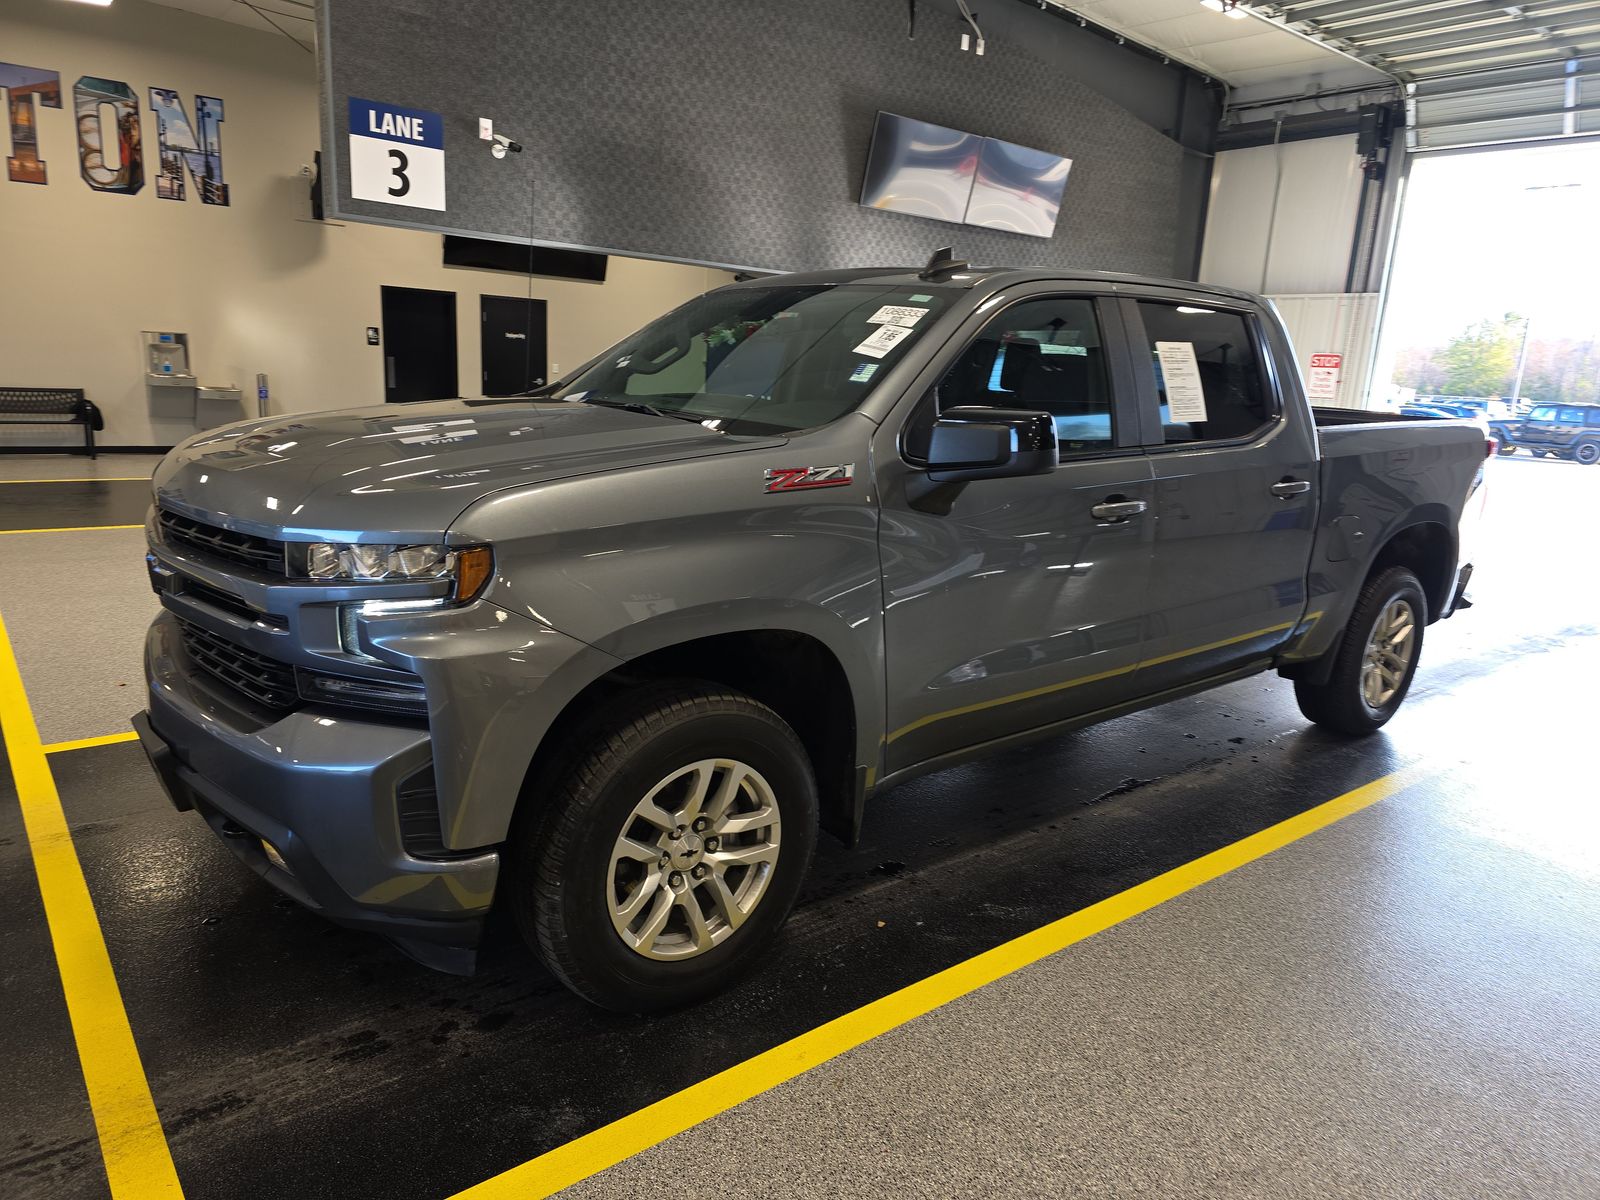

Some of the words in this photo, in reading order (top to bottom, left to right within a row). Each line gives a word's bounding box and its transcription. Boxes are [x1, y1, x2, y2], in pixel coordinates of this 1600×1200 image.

[368, 109, 425, 141] LANE
[387, 149, 410, 198] 3
[1311, 356, 1341, 367] STOP
[763, 462, 856, 494] Z71
